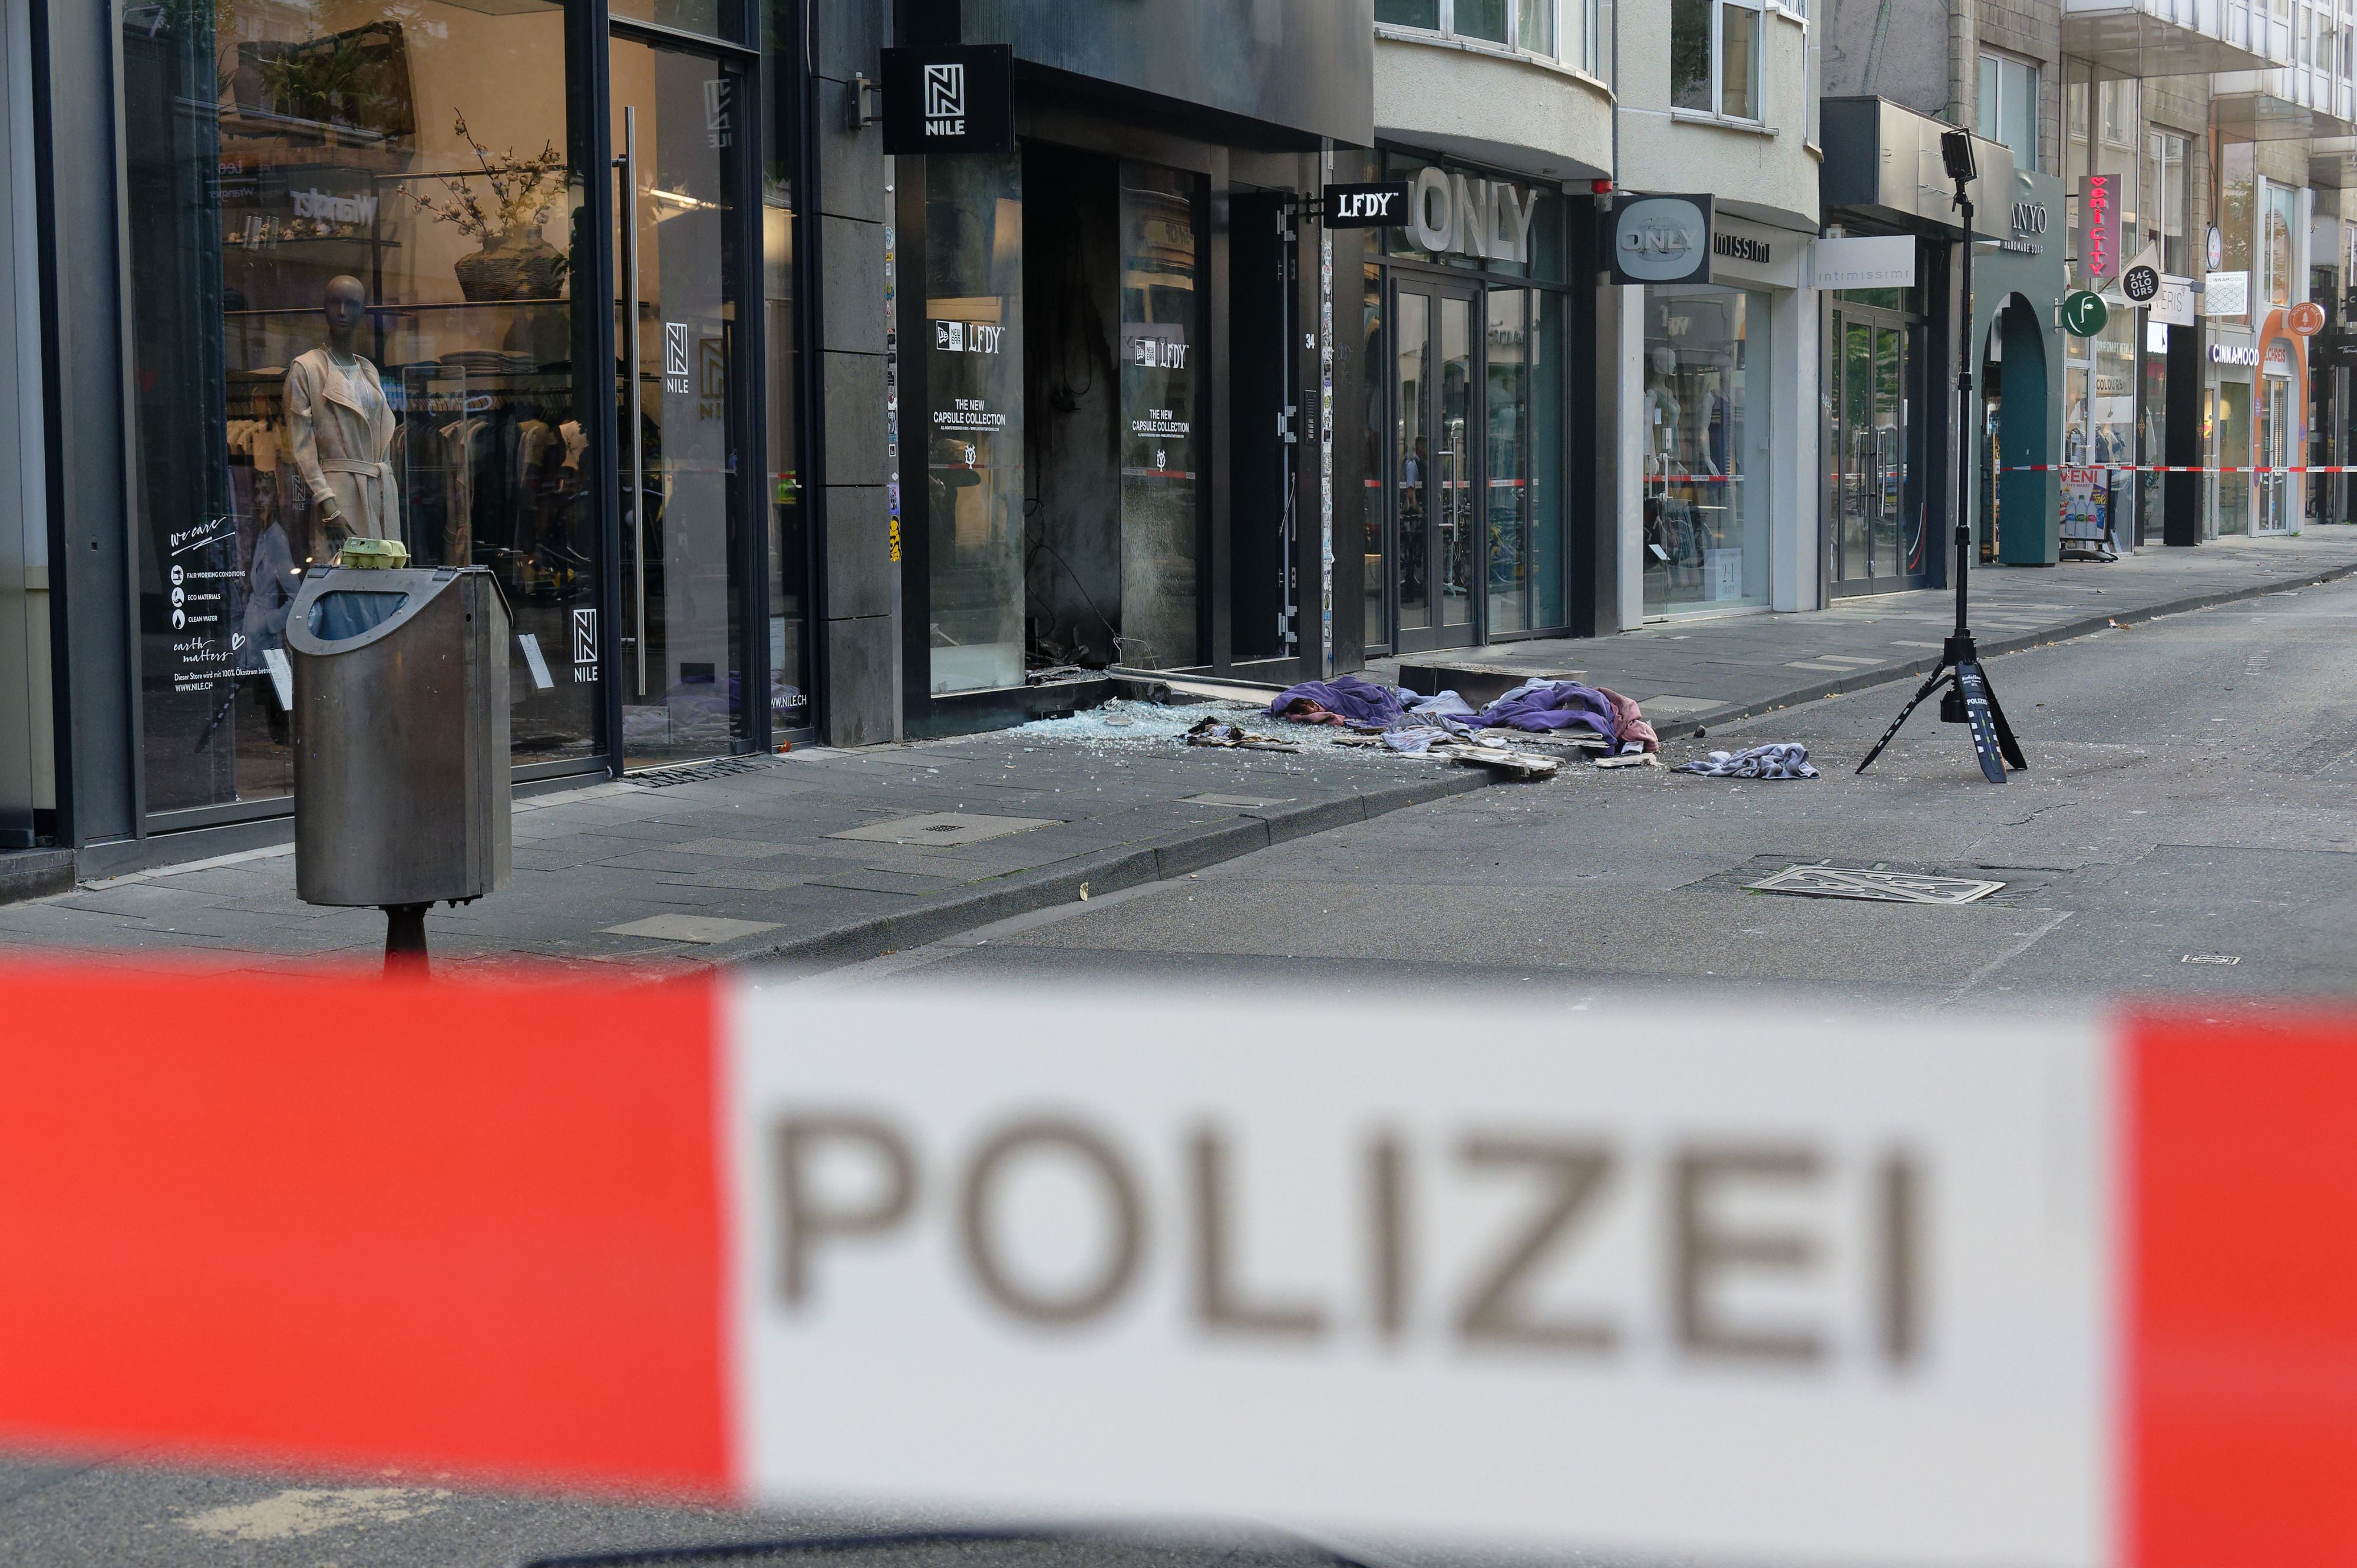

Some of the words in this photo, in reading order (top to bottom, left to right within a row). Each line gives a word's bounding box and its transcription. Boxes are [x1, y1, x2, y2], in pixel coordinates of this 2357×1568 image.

[926, 120, 965, 136] NILE
[1415, 166, 1537, 263] ONLY
[1621, 228, 1700, 250] ONLY
[2004, 241, 2029, 253] HANDMADE
[2031, 245, 2043, 255] SOAP
[1819, 270, 1909, 282] intimissimi
[2130, 270, 2150, 282] 24C
[2131, 278, 2151, 289] OLO
[2132, 286, 2153, 297] URS
[951, 336, 961, 345] ERA
[1305, 334, 1315, 349] 34
[2213, 344, 2260, 366] CINNAMOOD
[667, 378, 688, 393] NILE
[955, 399, 968, 411] THE
[969, 400, 984, 411] NEW
[933, 411, 964, 424] CAPSULE
[965, 412, 1006, 425] COLLECTION
[1149, 409, 1160, 419] THE
[1161, 410, 1172, 420] NEW
[1132, 421, 1156, 431] CAPSULE
[1157, 421, 1189, 433] COLLECTION
[2061, 470, 2097, 483] VENI
[171, 530, 190, 547] we
[192, 517, 226, 537] care
[173, 637, 215, 651] earth
[183, 649, 233, 662] matters
[174, 673, 189, 681] Dieser
[236, 667, 258, 676] Ökostrom
[575, 666, 598, 682] NILE
[175, 682, 213, 692] WWW.NILE.CH
[771, 1110, 1932, 1373] POLIZEI
